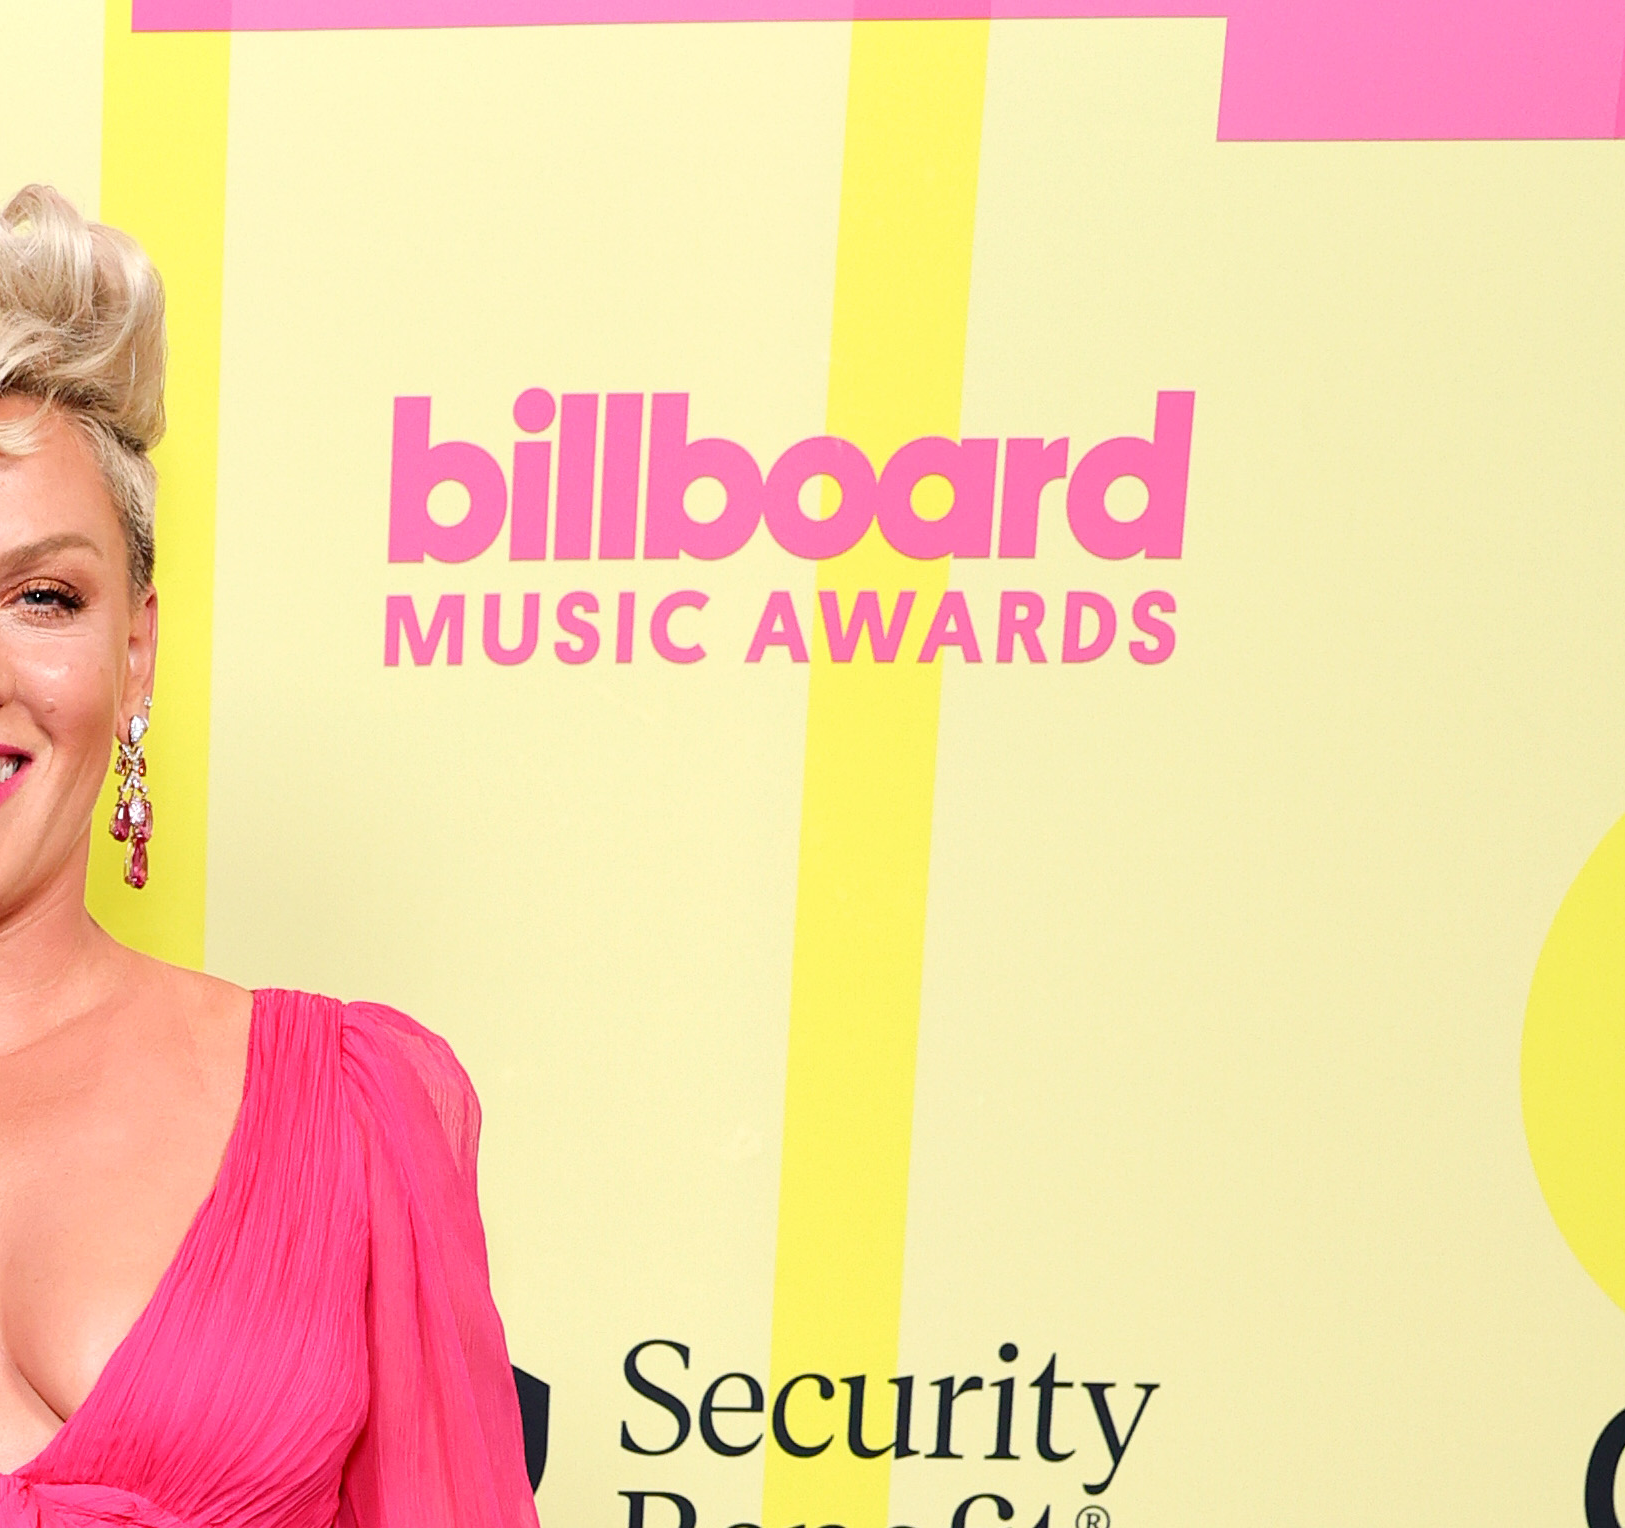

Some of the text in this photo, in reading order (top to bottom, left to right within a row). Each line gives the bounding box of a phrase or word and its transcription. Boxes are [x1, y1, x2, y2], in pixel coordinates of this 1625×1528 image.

[388, 387, 1195, 563] billboard
[384, 588, 1178, 667] MUSIC AWARDS
[619, 1339, 1160, 1495] Security
